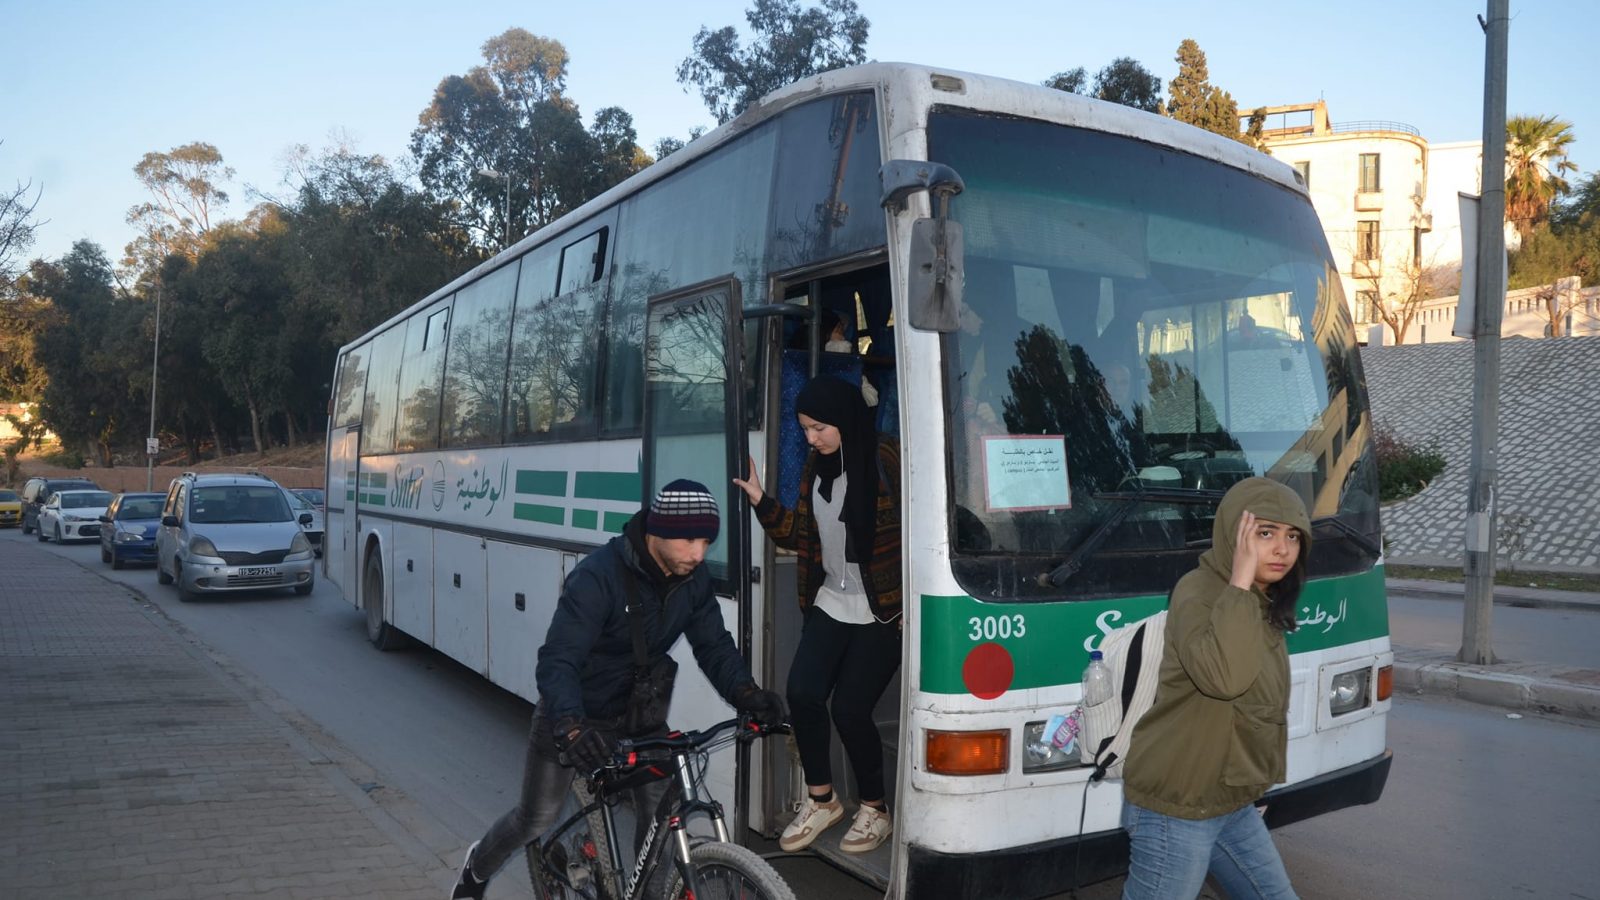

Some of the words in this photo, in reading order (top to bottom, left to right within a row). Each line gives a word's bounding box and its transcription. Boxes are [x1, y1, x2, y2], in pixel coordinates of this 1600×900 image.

[456, 458, 510, 518] الوطنية
[968, 614, 1026, 641] 3003
[623, 815, 660, 900] ROCKRIDER
